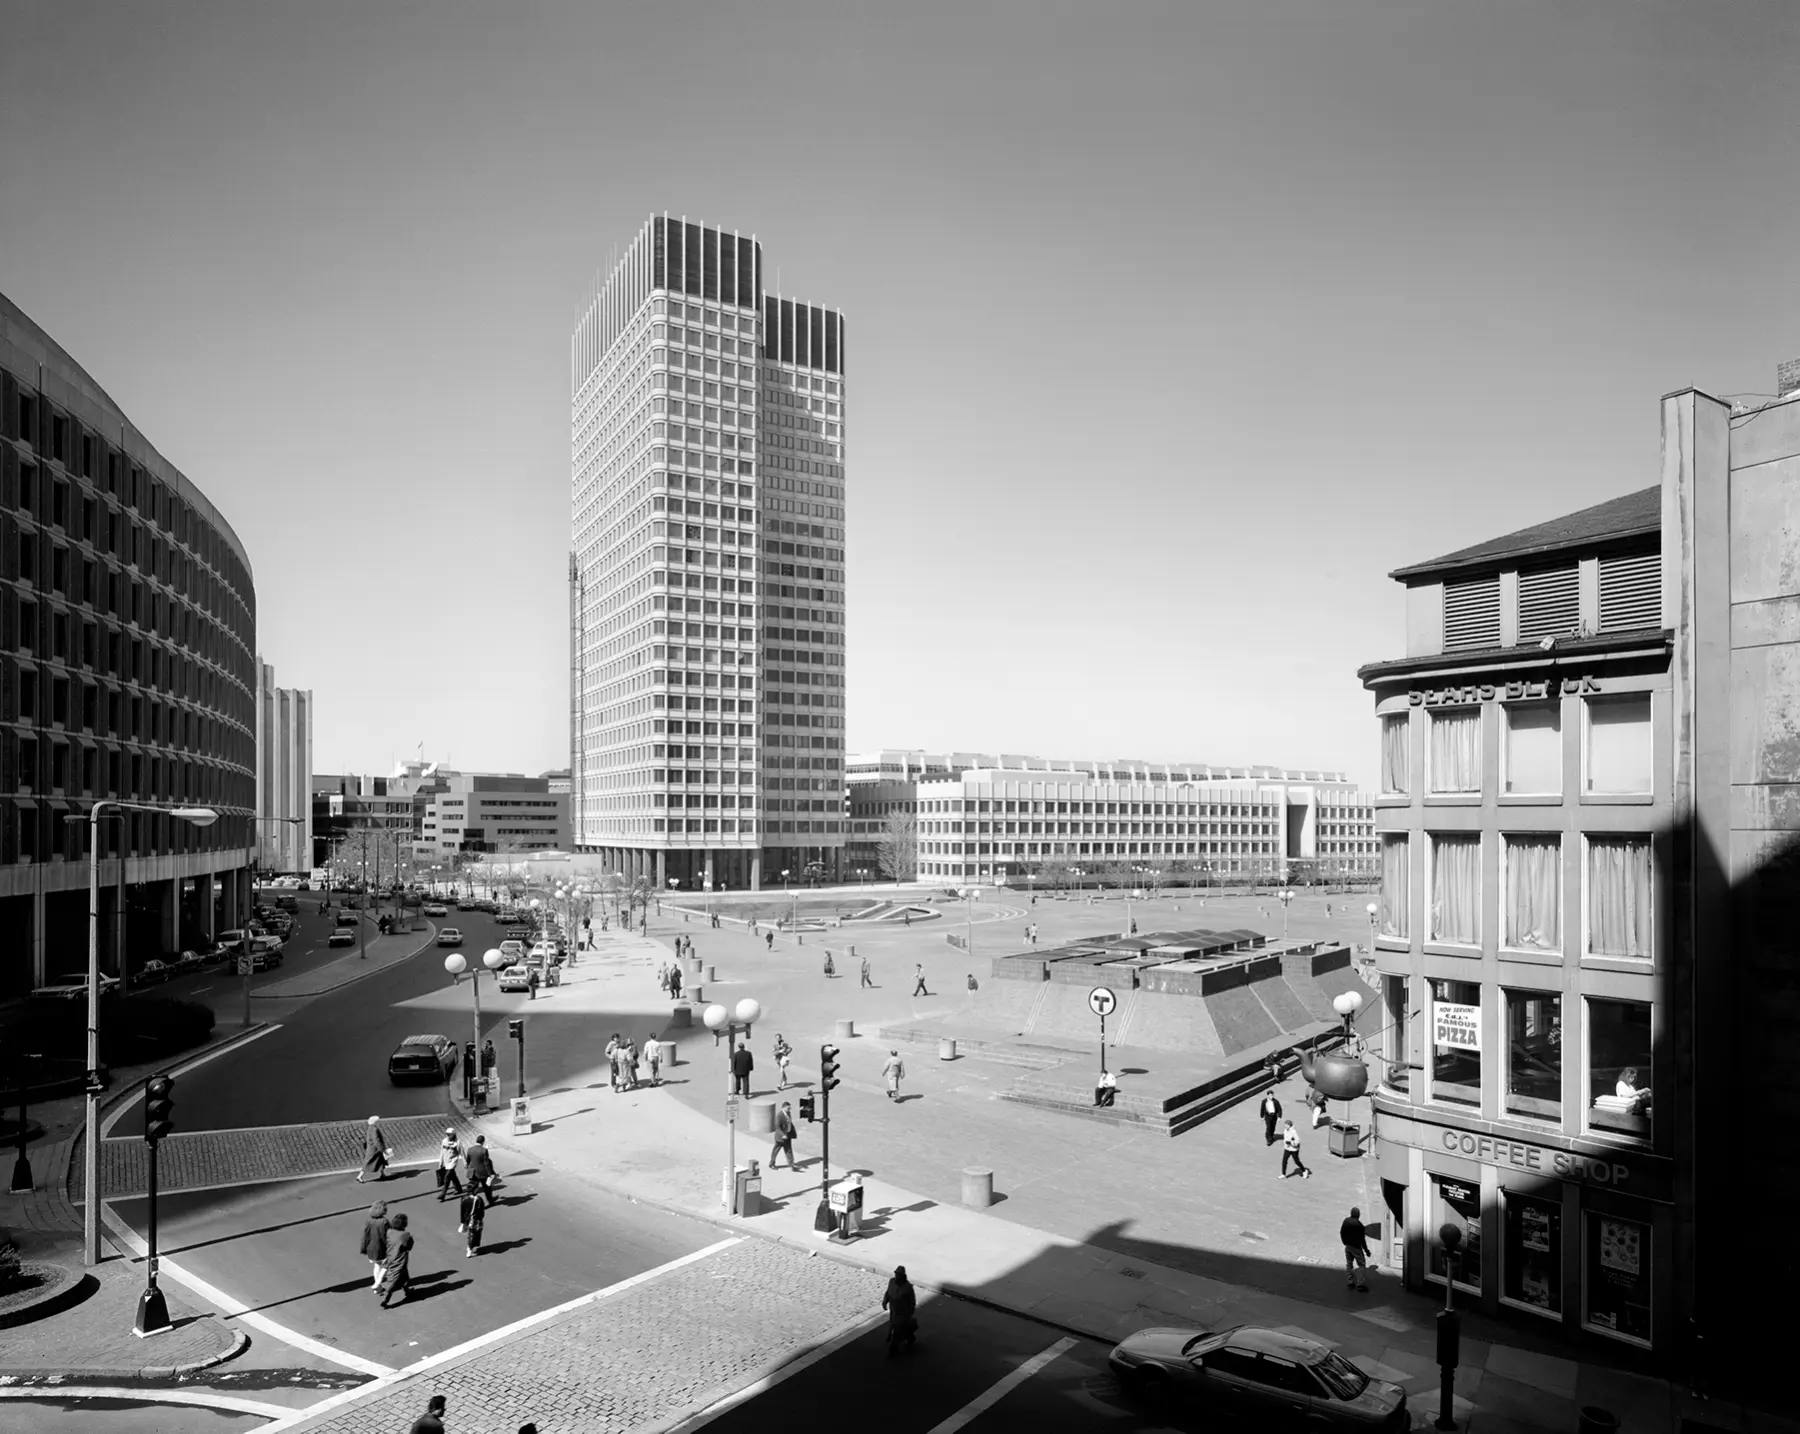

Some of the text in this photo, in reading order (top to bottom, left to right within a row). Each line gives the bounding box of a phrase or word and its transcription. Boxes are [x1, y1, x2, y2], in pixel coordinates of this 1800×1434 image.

[1408, 684, 1496, 707] SEARS
[1093, 995, 1110, 1012] T
[1437, 1017, 1477, 1029] FAMOUS
[1437, 1025, 1478, 1046] PIZZA
[1442, 1130, 1629, 1185] COFFEE SHOP
